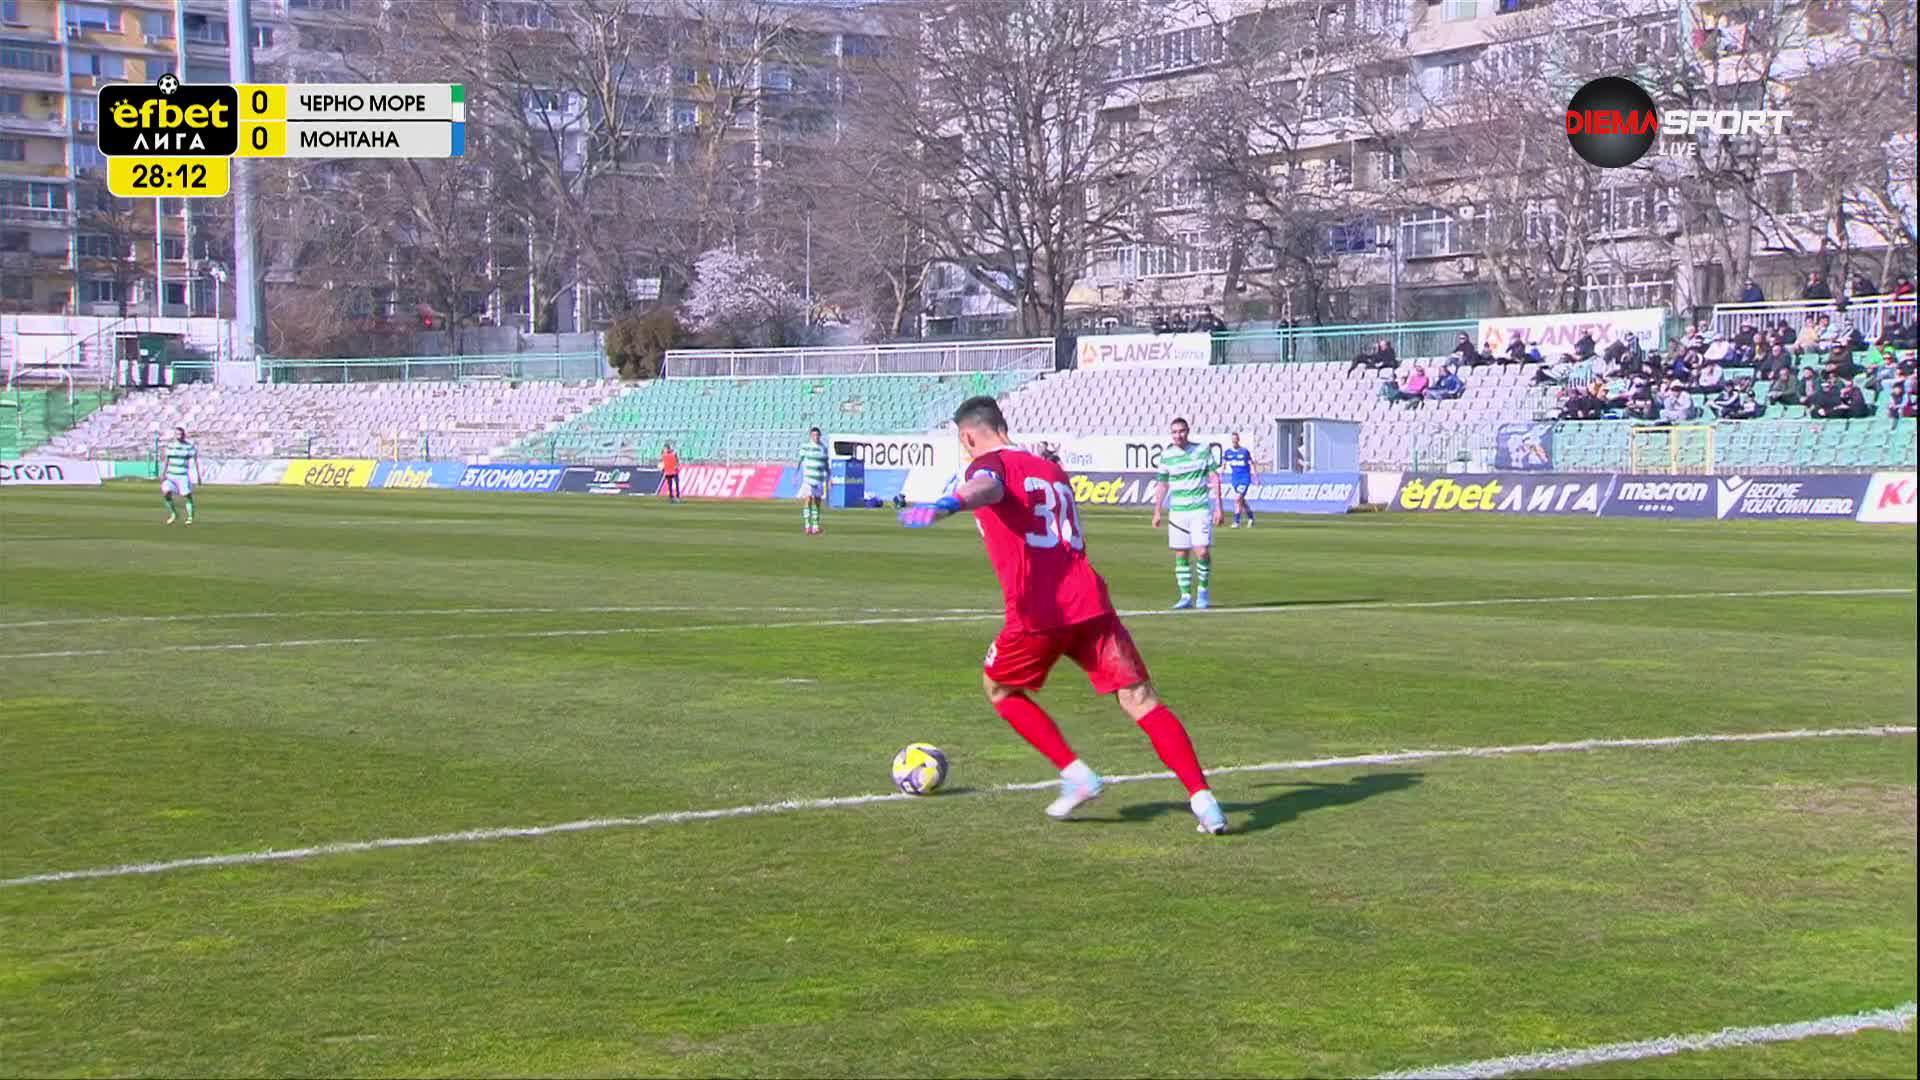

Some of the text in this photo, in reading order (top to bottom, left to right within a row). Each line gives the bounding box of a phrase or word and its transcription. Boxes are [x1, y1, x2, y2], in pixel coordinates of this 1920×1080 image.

[1099, 343, 1174, 363] PLANEX
[1125, 442, 1222, 469] man
[304, 464, 355, 487] efbet
[1497, 483, 1598, 512] ЛИГА
[1618, 482, 1709, 502] macron
[1746, 483, 1803, 498] BECOME
[1024, 476, 1084, 551] 30
[1740, 498, 1775, 513] YOUR
[1776, 499, 1811, 514] OWN
